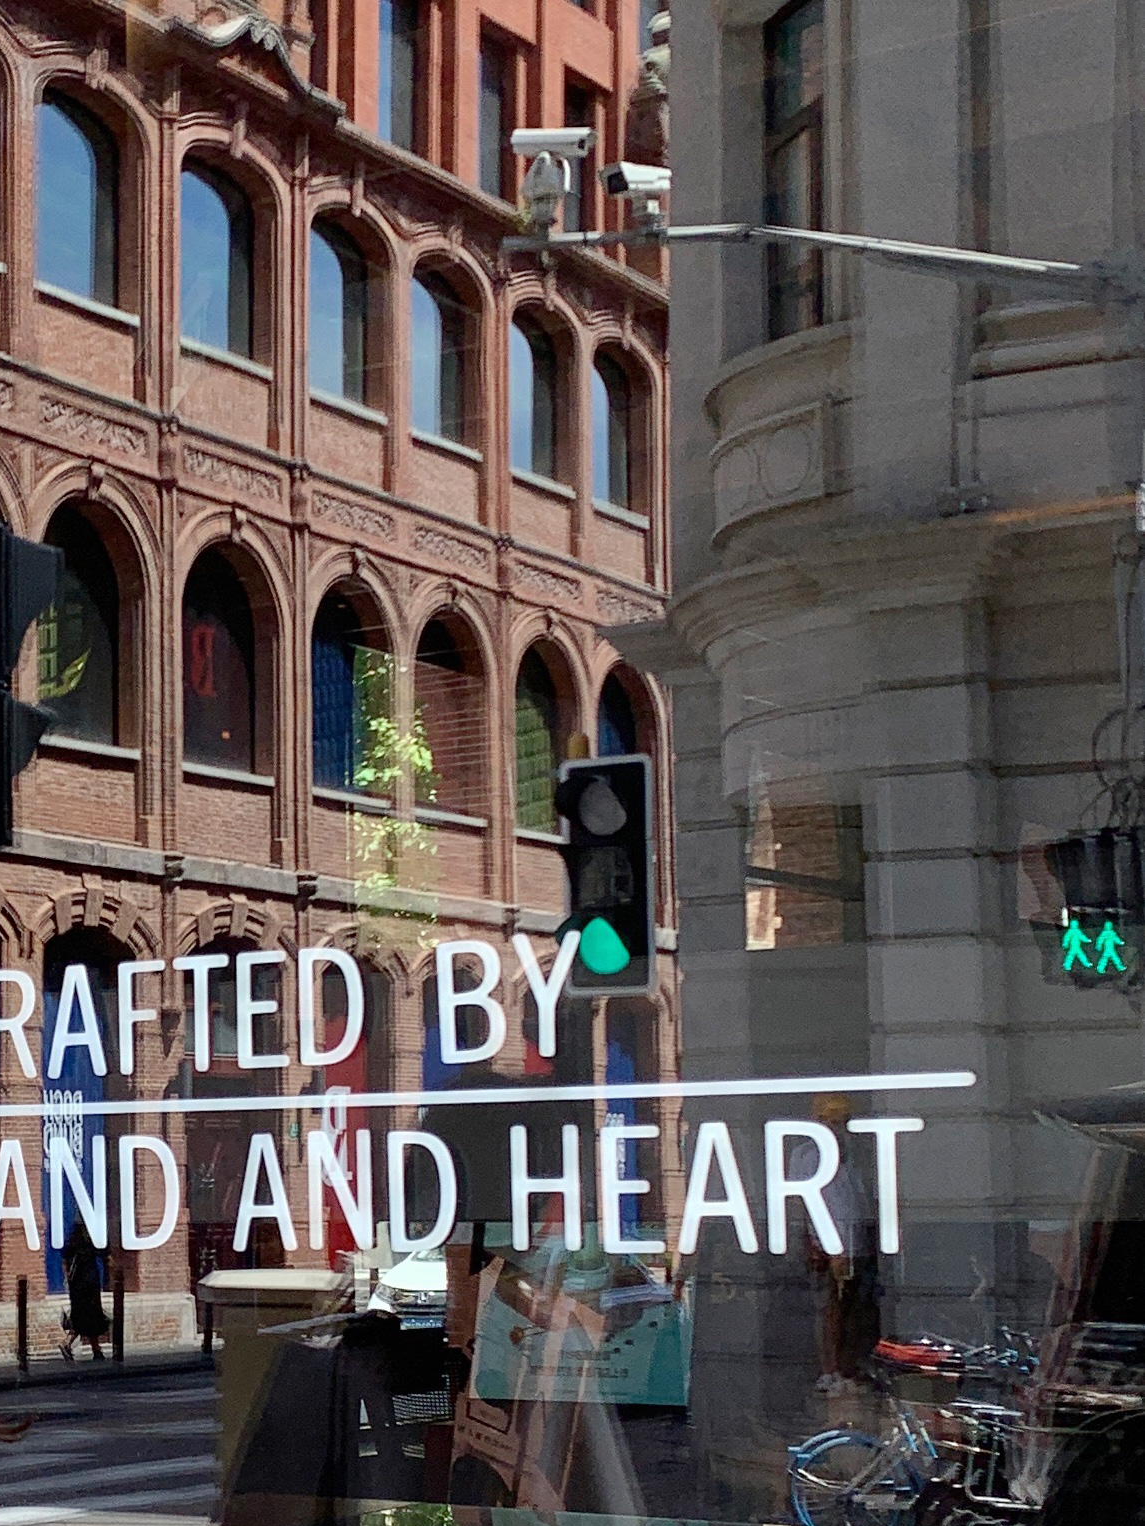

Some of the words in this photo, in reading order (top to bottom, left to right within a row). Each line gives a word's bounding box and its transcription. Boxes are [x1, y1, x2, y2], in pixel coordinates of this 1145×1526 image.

[435, 930, 580, 1064] BY
[233, 1130, 459, 1253] AND
[509, 1118, 924, 1255] HEART
